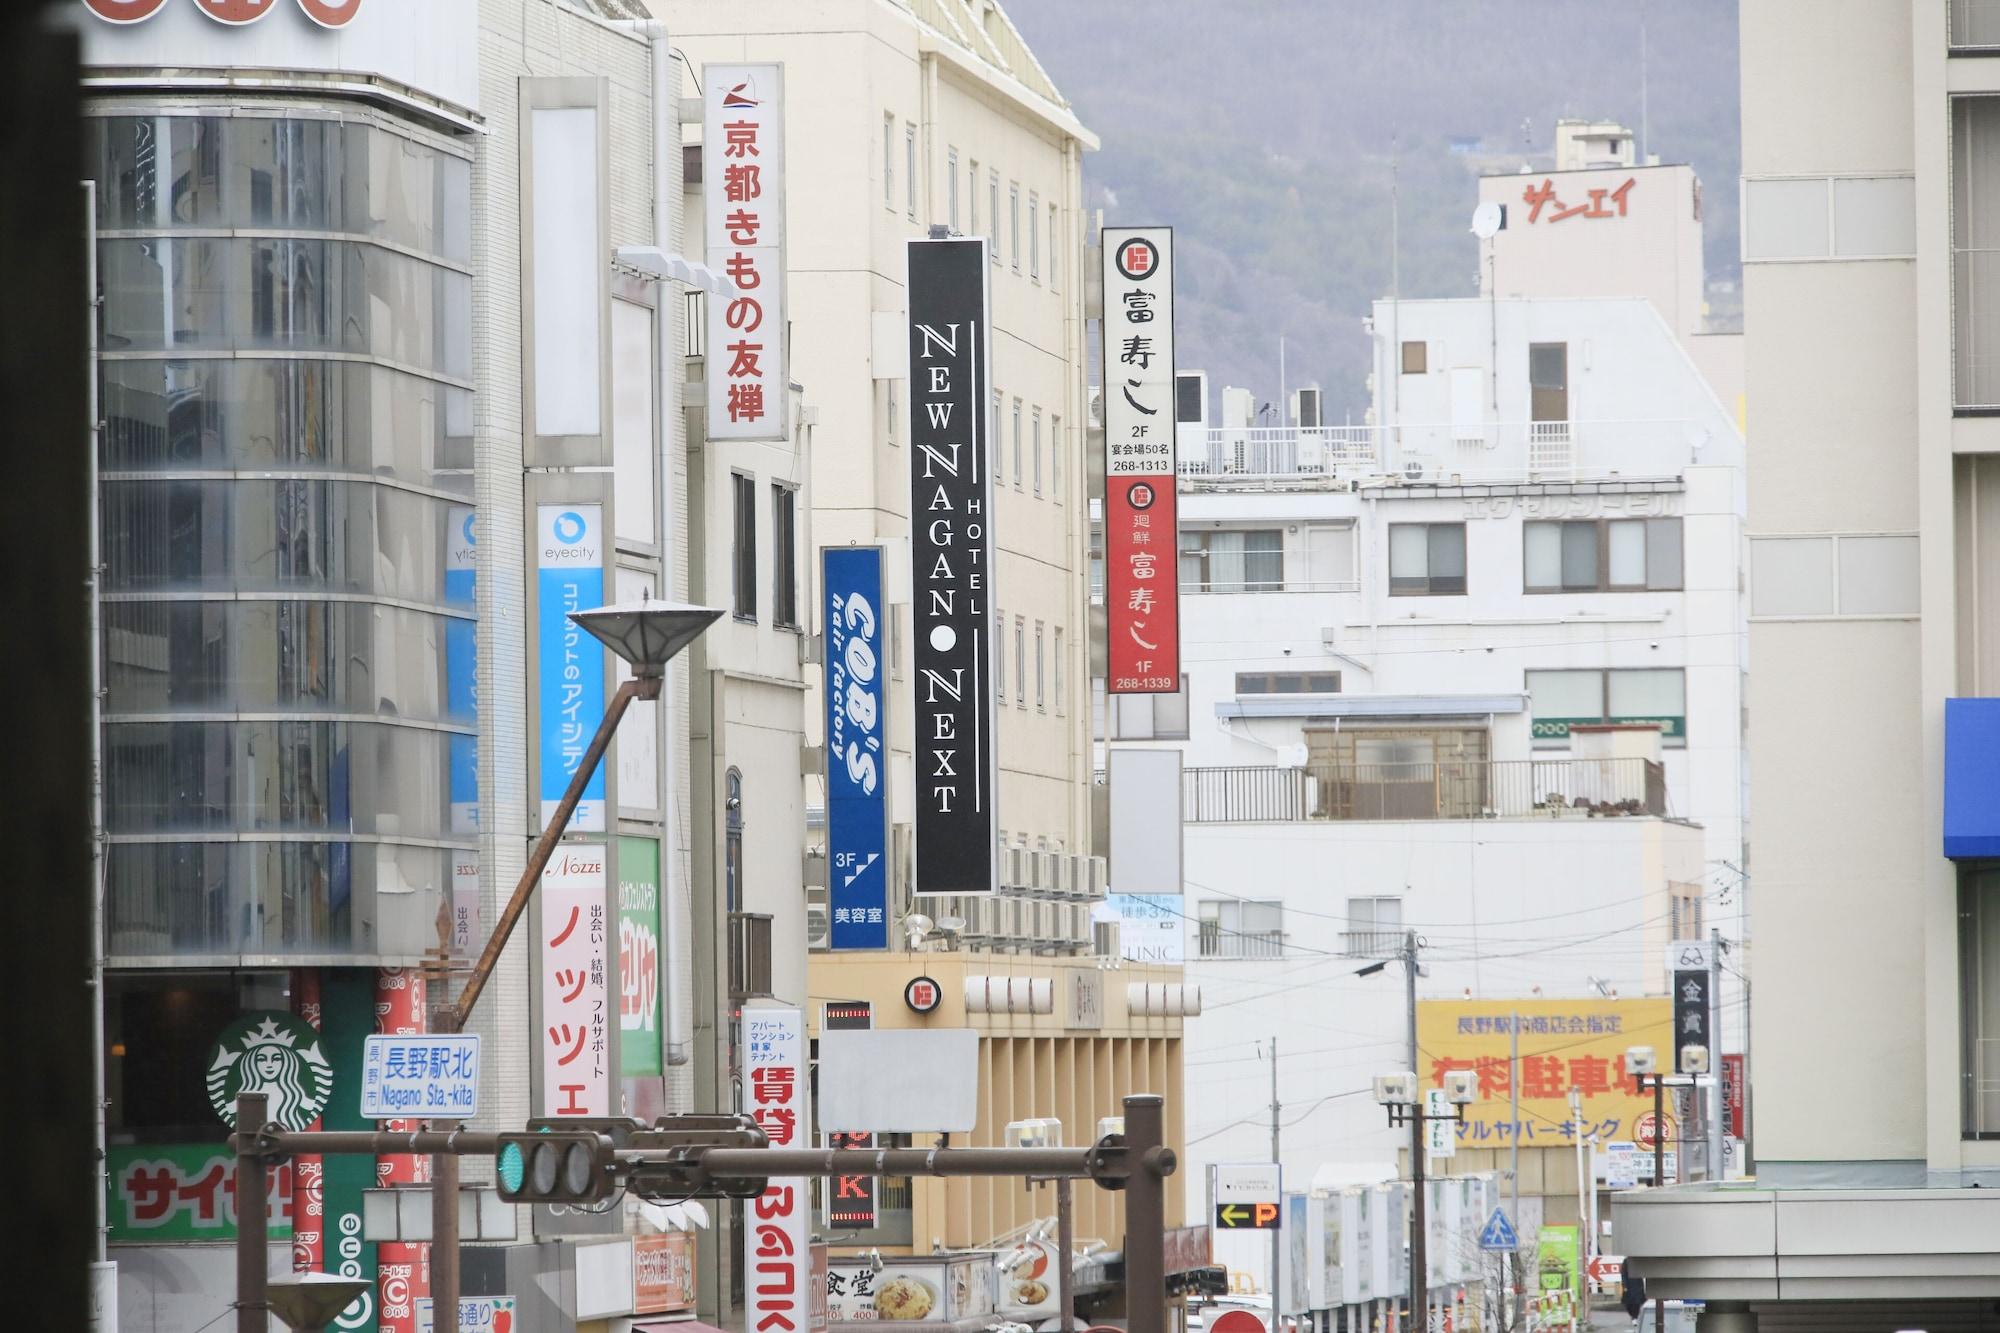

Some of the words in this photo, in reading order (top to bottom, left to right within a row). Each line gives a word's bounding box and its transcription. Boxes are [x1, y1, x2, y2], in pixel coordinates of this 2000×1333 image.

[1523, 178, 1636, 225] サンエイ
[723, 120, 764, 423] 京都きもの友禅
[915, 323, 960, 430] NEW
[1131, 425, 1149, 438] 2F
[1111, 443, 1170, 456] 宴会場50名
[1113, 460, 1168, 472] 268-1313
[545, 547, 595, 562] eyecity
[967, 498, 982, 615] HOTEL
[832, 591, 844, 652] hair
[1135, 660, 1153, 673] 1F
[1116, 678, 1171, 689] 268-1339
[831, 655, 845, 761] factory
[919, 668, 965, 813] NEXT
[569, 806, 589, 825] F
[835, 852, 856, 868] 3F
[835, 907, 883, 925] 美容室
[751, 1022, 785, 1031] アパート
[751, 1032, 795, 1041] マンション
[385, 1047, 473, 1080] 長野駅北
[751, 1053, 786, 1062] テナント
[382, 1084, 421, 1110] Nagano
[751, 1067, 796, 1146] 賃貸
[1255, 1203, 1277, 1227] P
